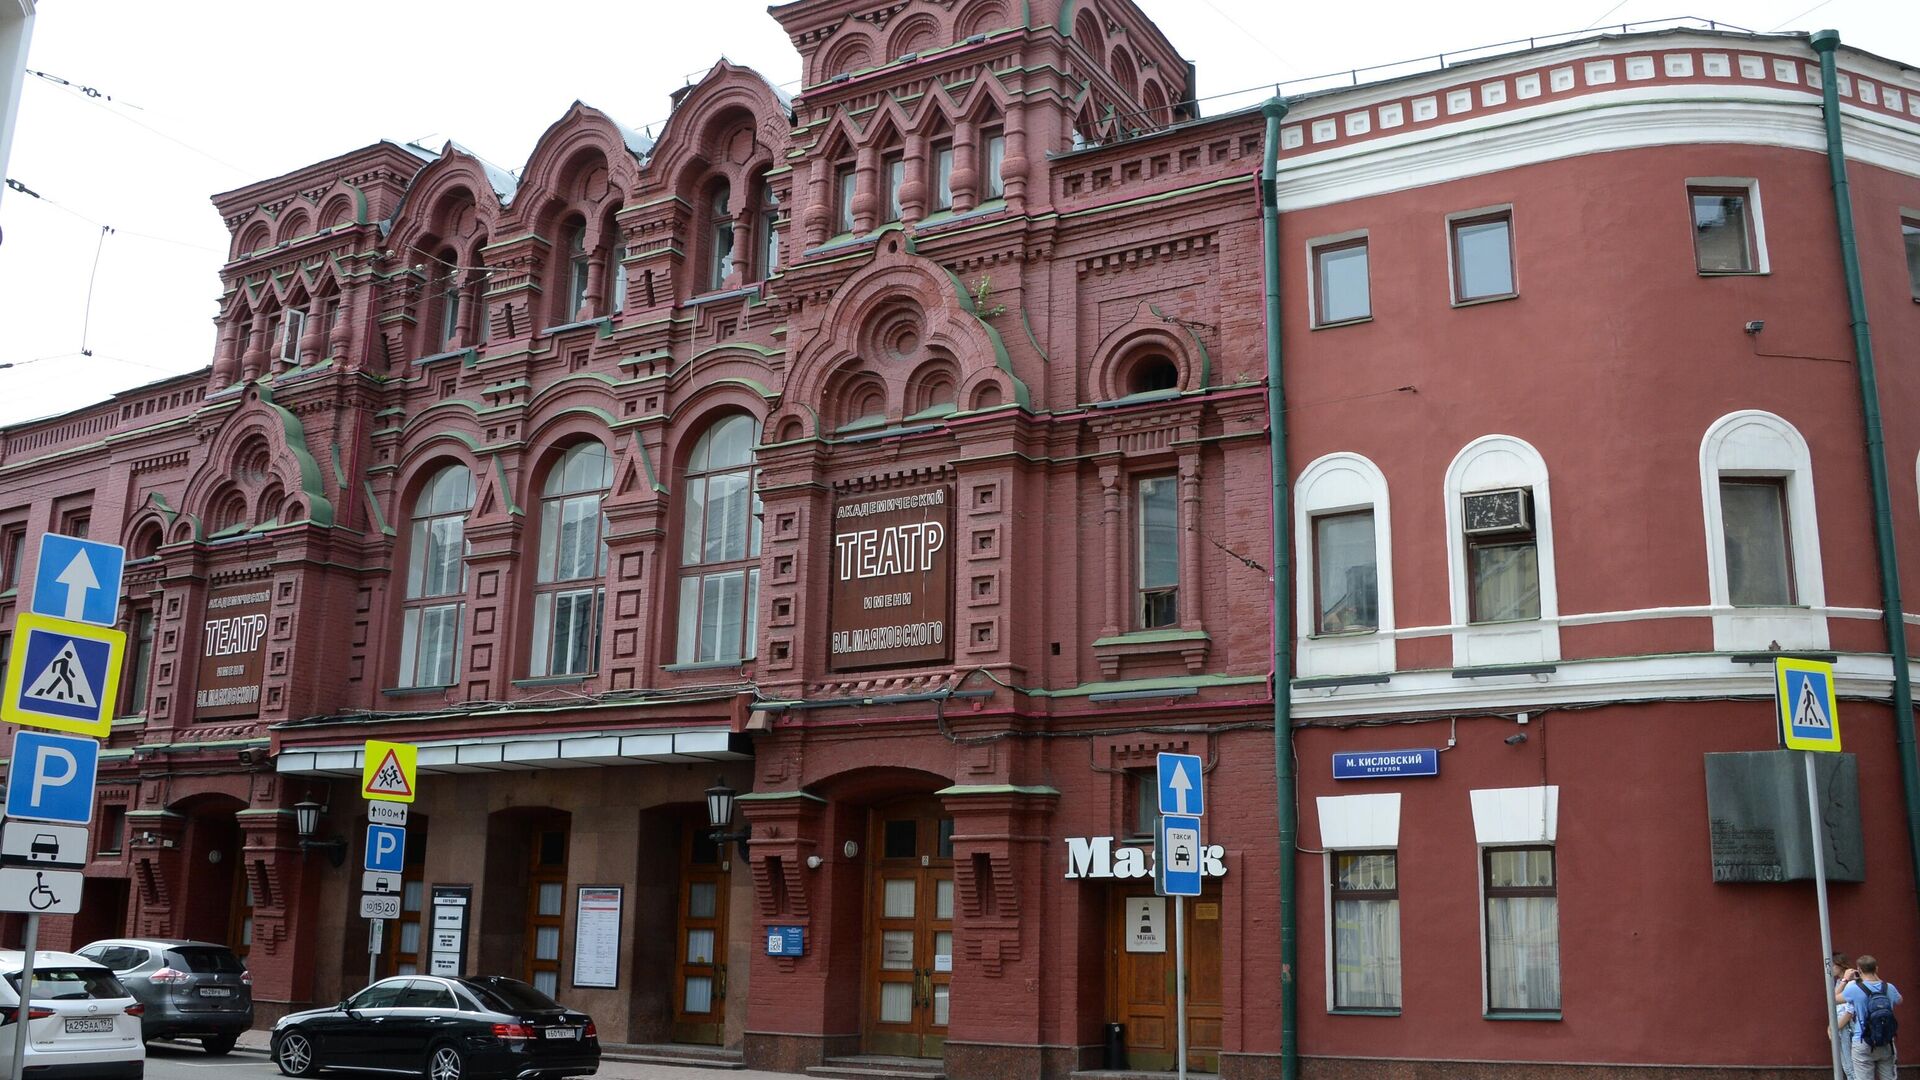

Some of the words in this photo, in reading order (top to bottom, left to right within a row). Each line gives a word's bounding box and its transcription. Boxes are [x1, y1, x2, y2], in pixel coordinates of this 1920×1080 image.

[837, 490, 944, 518] АКАДЕМИЧЕСКИЙ
[836, 521, 944, 580] ТЕАТР
[208, 590, 270, 609] АКАДЕМИЧЕСКИЙ
[864, 592, 912, 610] ИМЕНИ
[206, 614, 267, 657] ТЕАТР
[1346, 758, 1356, 767] М.
[1359, 754, 1422, 767] КИСЛОВСКИЙ
[30, 746, 77, 807] P
[376, 832, 396, 864] P
[384, 903, 395, 912] 20
